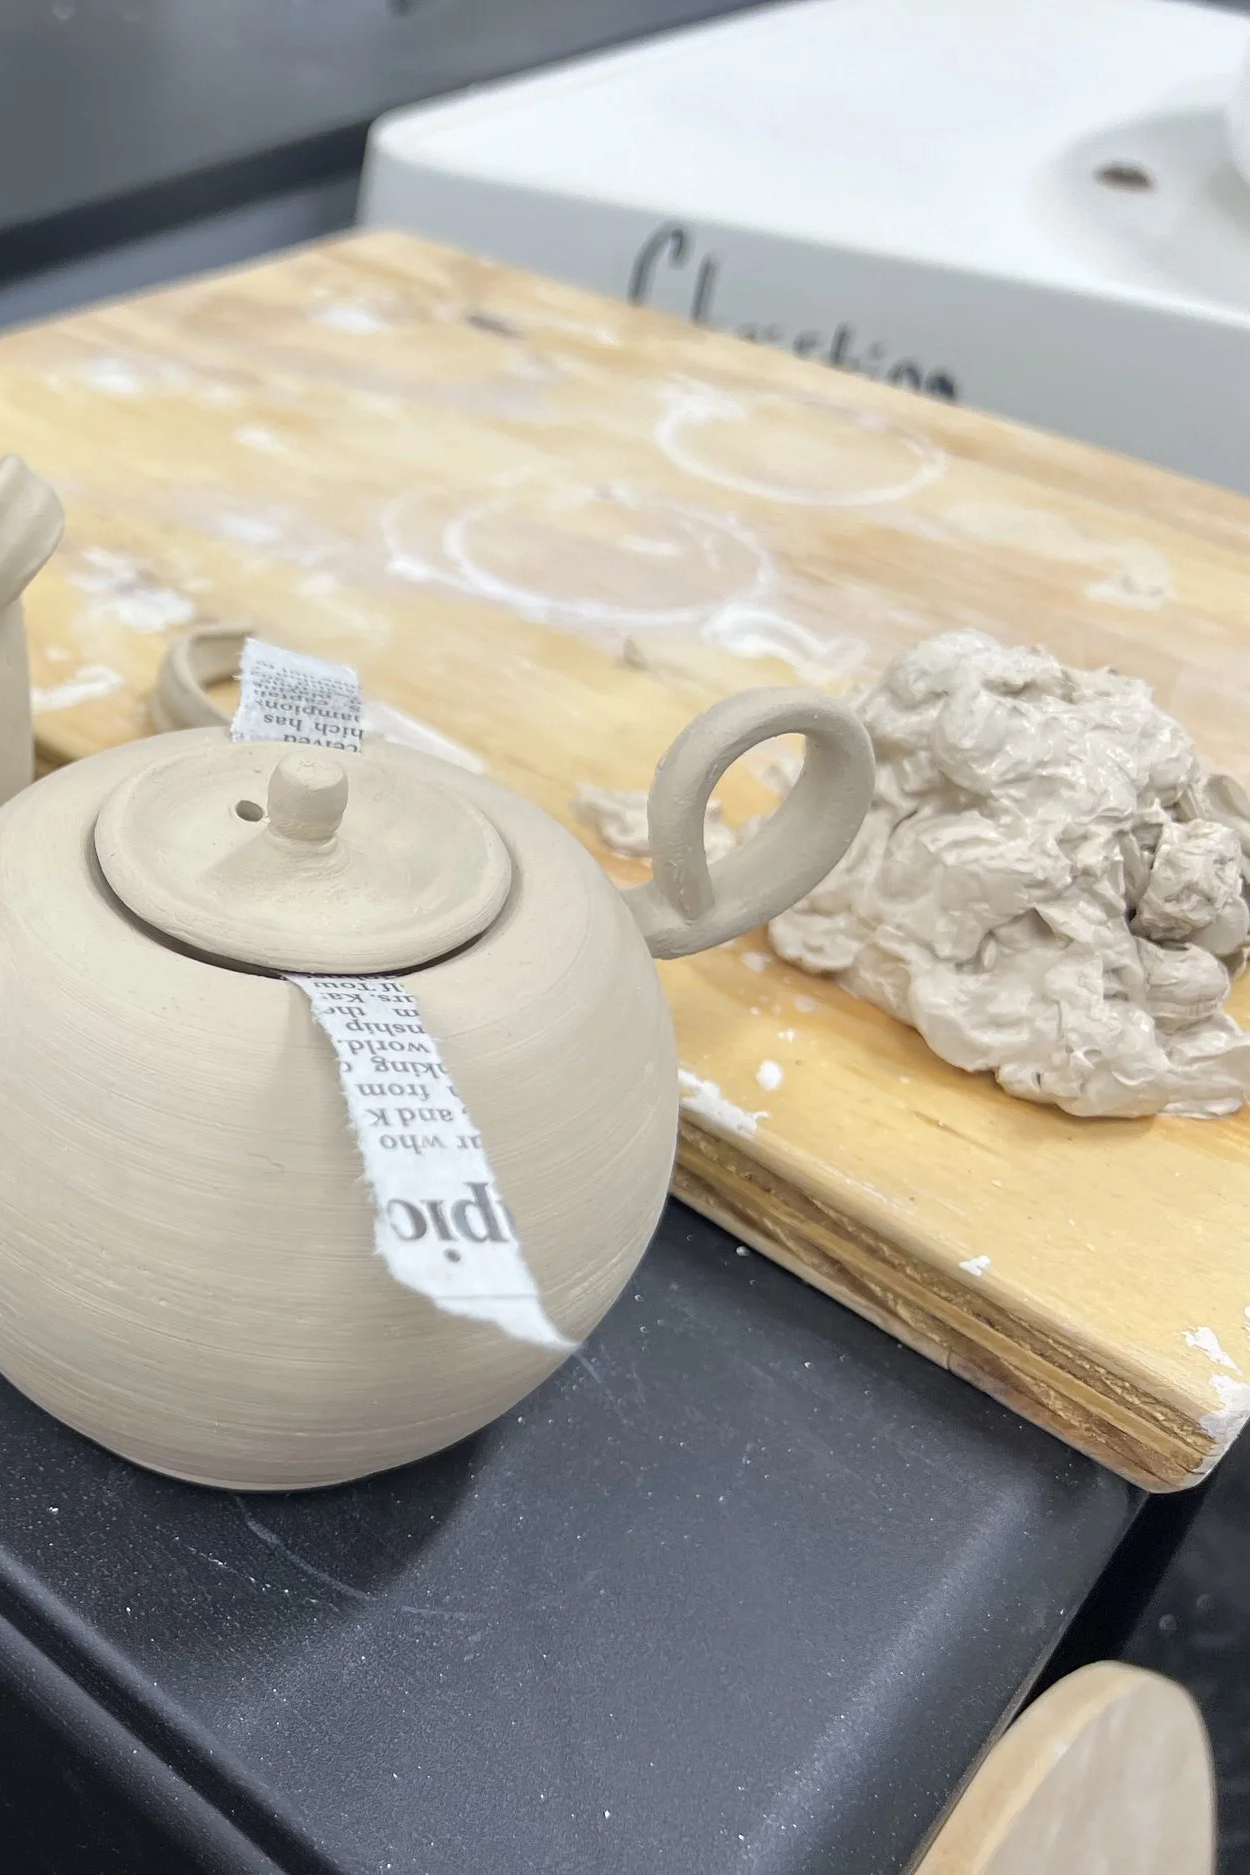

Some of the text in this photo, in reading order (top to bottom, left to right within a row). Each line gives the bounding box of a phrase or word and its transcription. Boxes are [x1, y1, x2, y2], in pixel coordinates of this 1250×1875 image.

[263, 715, 363, 740] hich has
[346, 1020, 425, 1037] nship
[337, 1039, 430, 1055] world.
[356, 1083, 430, 1101] from
[364, 1108, 453, 1128] and K
[379, 1134, 446, 1156] who
